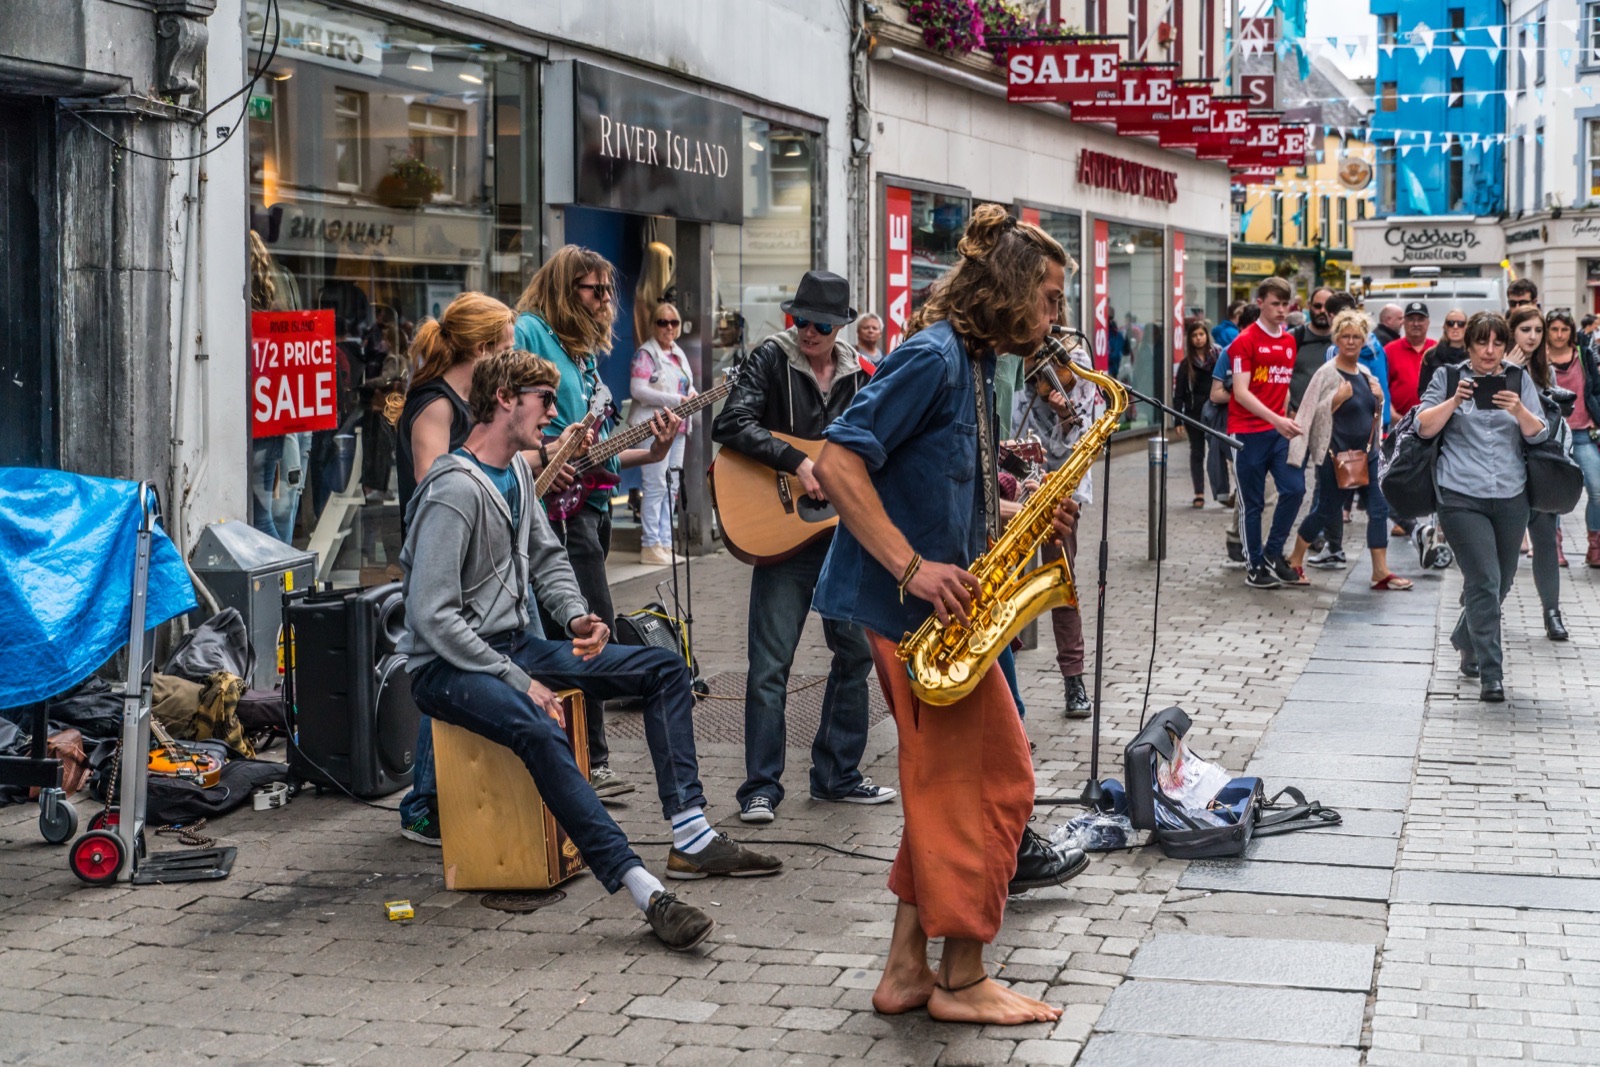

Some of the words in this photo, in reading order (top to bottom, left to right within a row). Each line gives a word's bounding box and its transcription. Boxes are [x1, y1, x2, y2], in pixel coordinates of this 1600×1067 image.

[1009, 53, 1118, 84] SALE
[1249, 79, 1267, 105] S
[600, 114, 659, 166] RIVER
[665, 130, 729, 179] ISLAND
[1077, 148, 1143, 196] ANTHONY
[1143, 165, 1178, 204] RYANS
[1384, 226, 1481, 251] Claddagh
[1391, 247, 1467, 263] Jewellers
[1095, 240, 1108, 357] SALE
[1173, 248, 1184, 350] SALE
[270, 320, 289, 334] RIVER
[291, 320, 315, 334] ISLAND
[253, 340, 280, 373] 1/2
[284, 339, 332, 367] PRICE
[254, 371, 333, 423] SALE
